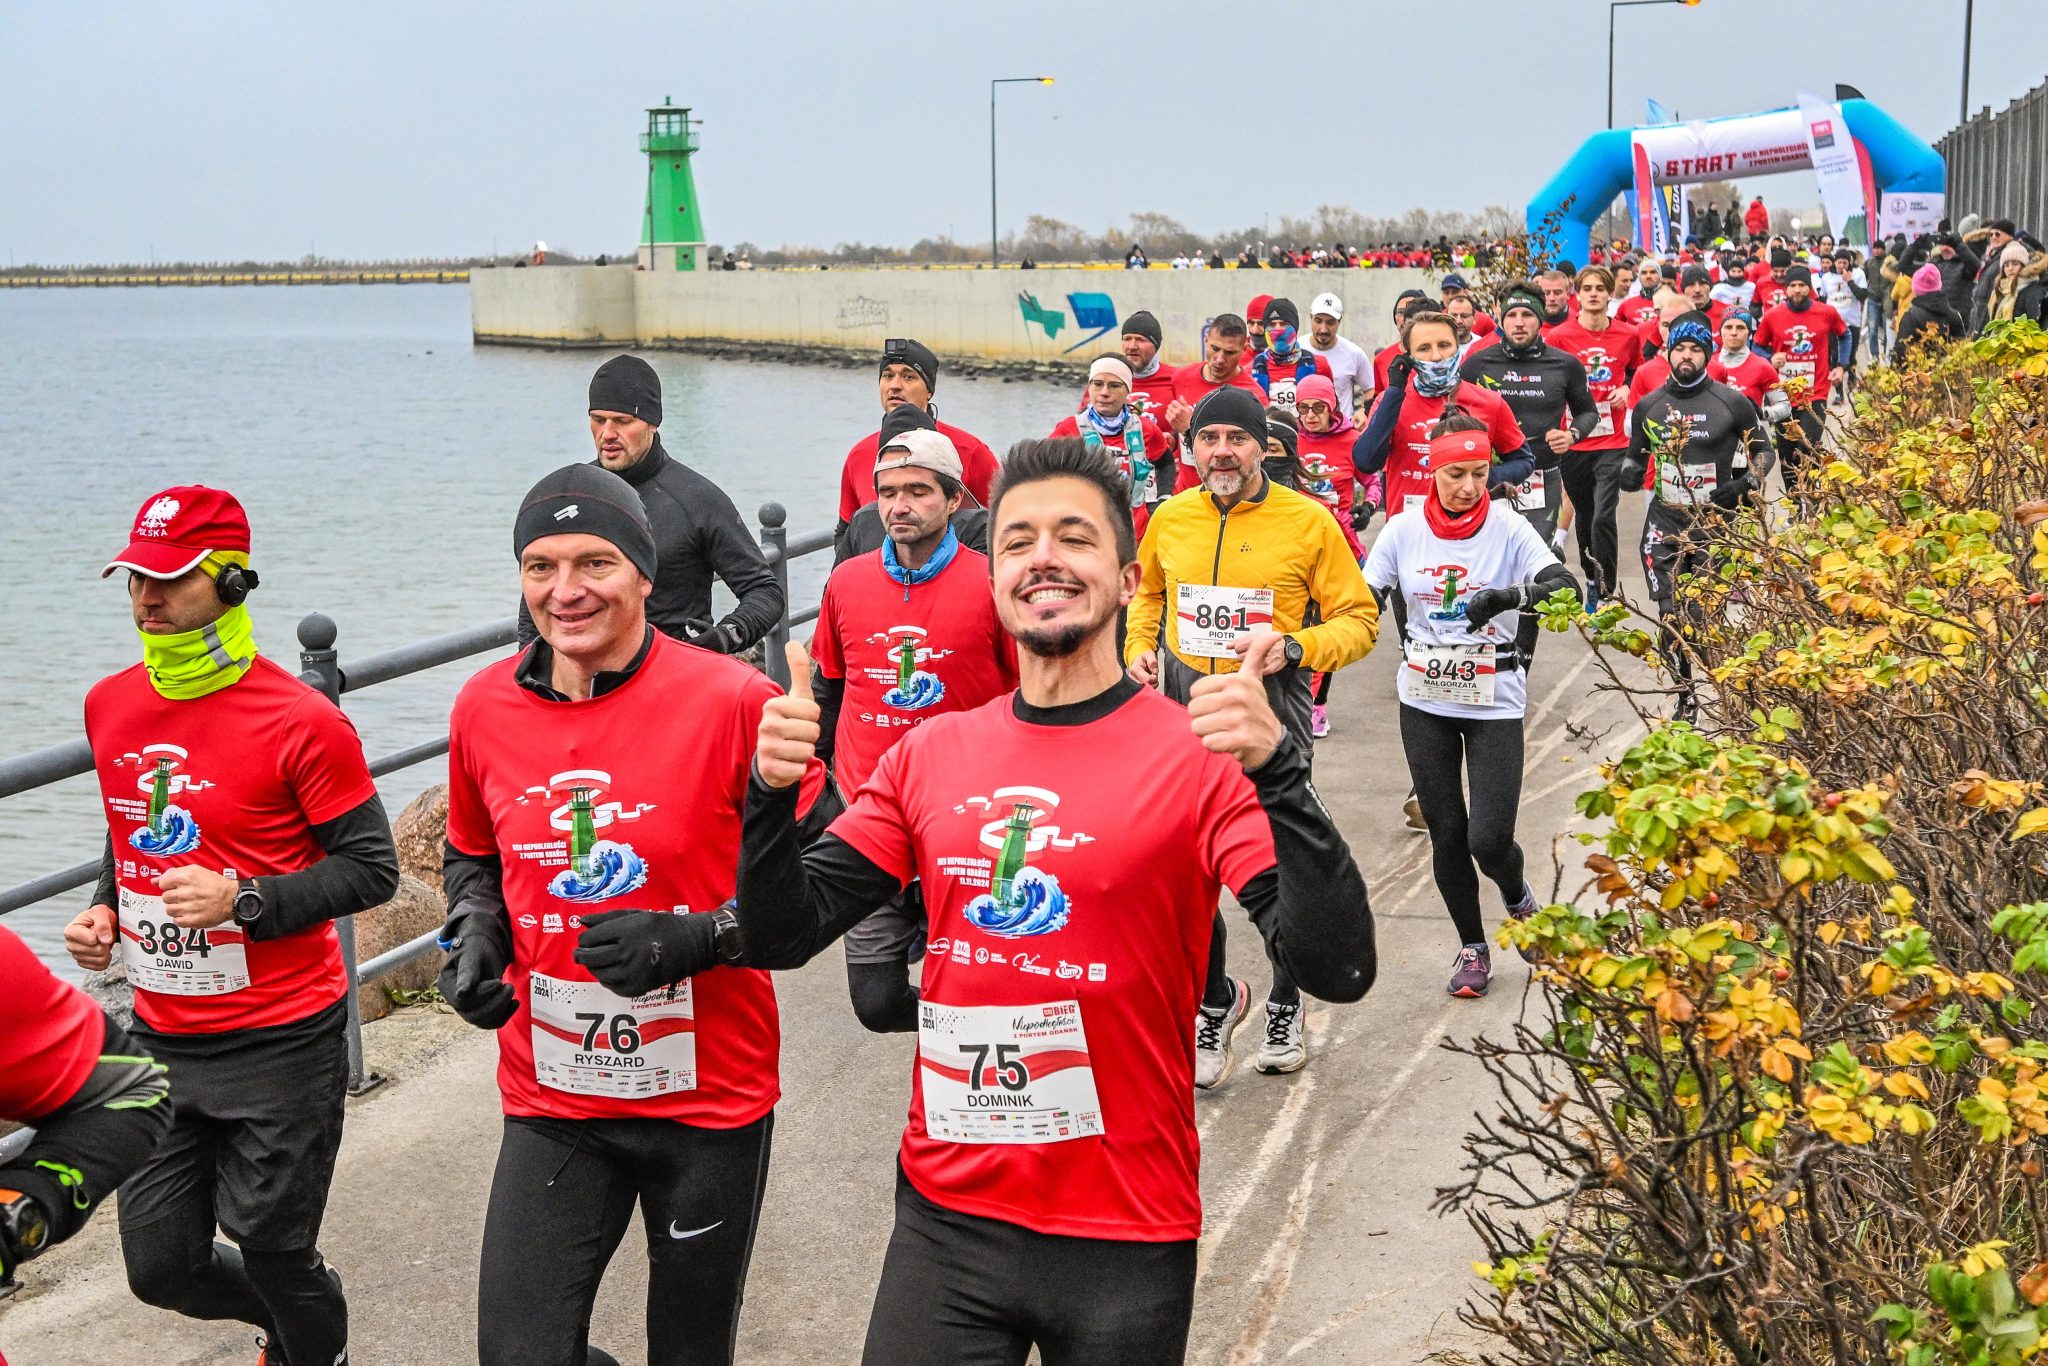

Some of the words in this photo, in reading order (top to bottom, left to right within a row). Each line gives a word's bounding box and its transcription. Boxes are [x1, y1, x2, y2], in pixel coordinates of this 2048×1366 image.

[1666, 153, 1737, 177] START
[136, 526, 169, 538] POLSKA
[1195, 603, 1251, 632] 861
[1208, 631, 1235, 640] PIOTR
[1425, 658, 1477, 682] 843
[1423, 678, 1478, 690] MAŁGORZATA
[137, 920, 212, 959] 384
[156, 958, 194, 970] DAWID
[534, 987, 550, 998] 2024
[636, 1002, 662, 1010] PORTEM
[1053, 1004, 1076, 1016] BIEG
[922, 1017, 936, 1030] 2024
[574, 1012, 640, 1055] 76
[1019, 1031, 1048, 1039] PORTEM
[574, 1053, 645, 1068] RYSZARD
[958, 1043, 1029, 1092] 75
[967, 1094, 1034, 1107] DOMINIK
[1080, 1114, 1097, 1122] QUIZ
